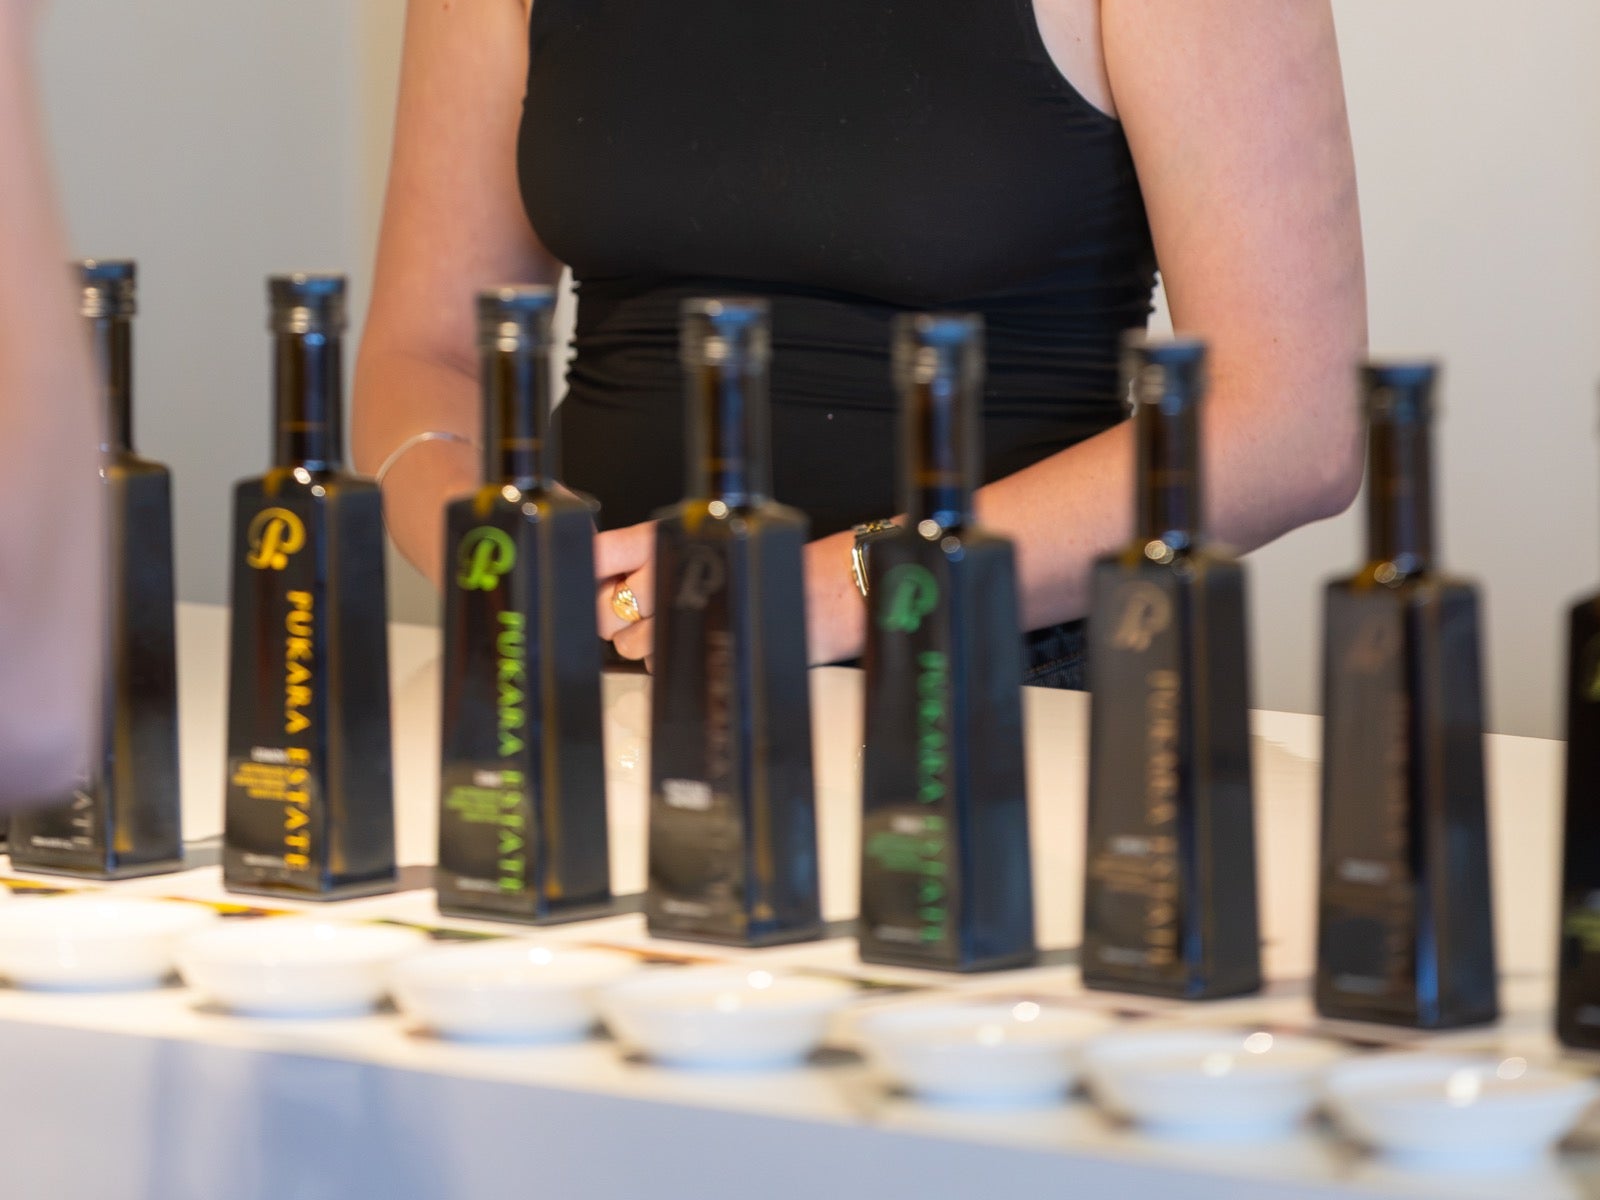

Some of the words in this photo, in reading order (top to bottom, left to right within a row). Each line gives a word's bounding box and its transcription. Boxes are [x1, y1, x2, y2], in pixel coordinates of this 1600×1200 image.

[284, 590, 313, 734] PUKARA
[498, 611, 526, 758] PUKARA
[284, 747, 312, 870] ESTATE
